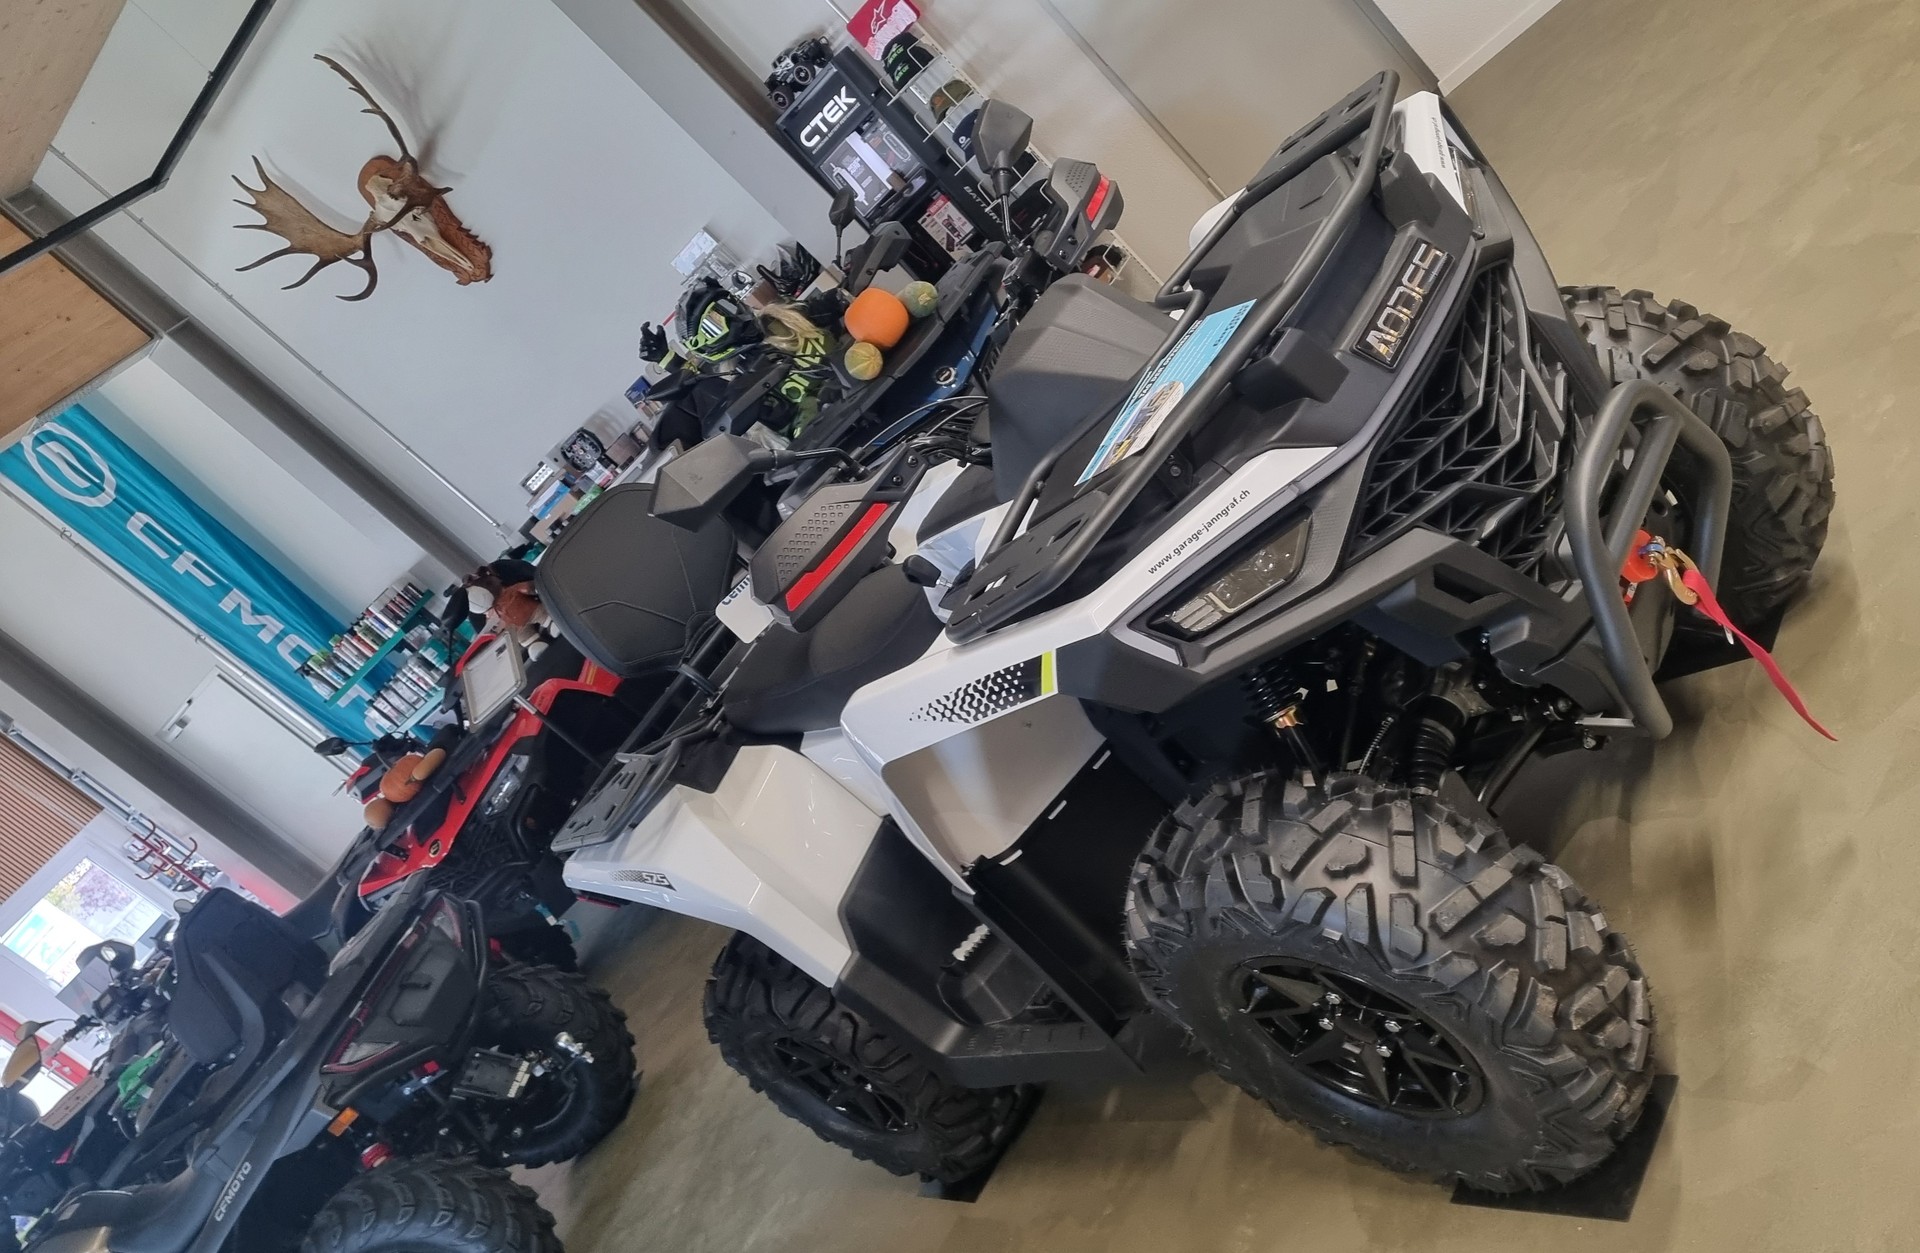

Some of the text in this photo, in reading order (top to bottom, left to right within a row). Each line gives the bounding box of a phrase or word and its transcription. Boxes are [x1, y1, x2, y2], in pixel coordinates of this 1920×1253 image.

[800, 85, 857, 149] CTEK
[1366, 243, 1449, 362] AODES
[1147, 489, 1250, 575] www.garage-janngraf.ch
[642, 873, 671, 885] 525
[214, 1161, 252, 1222] CFMOTO
